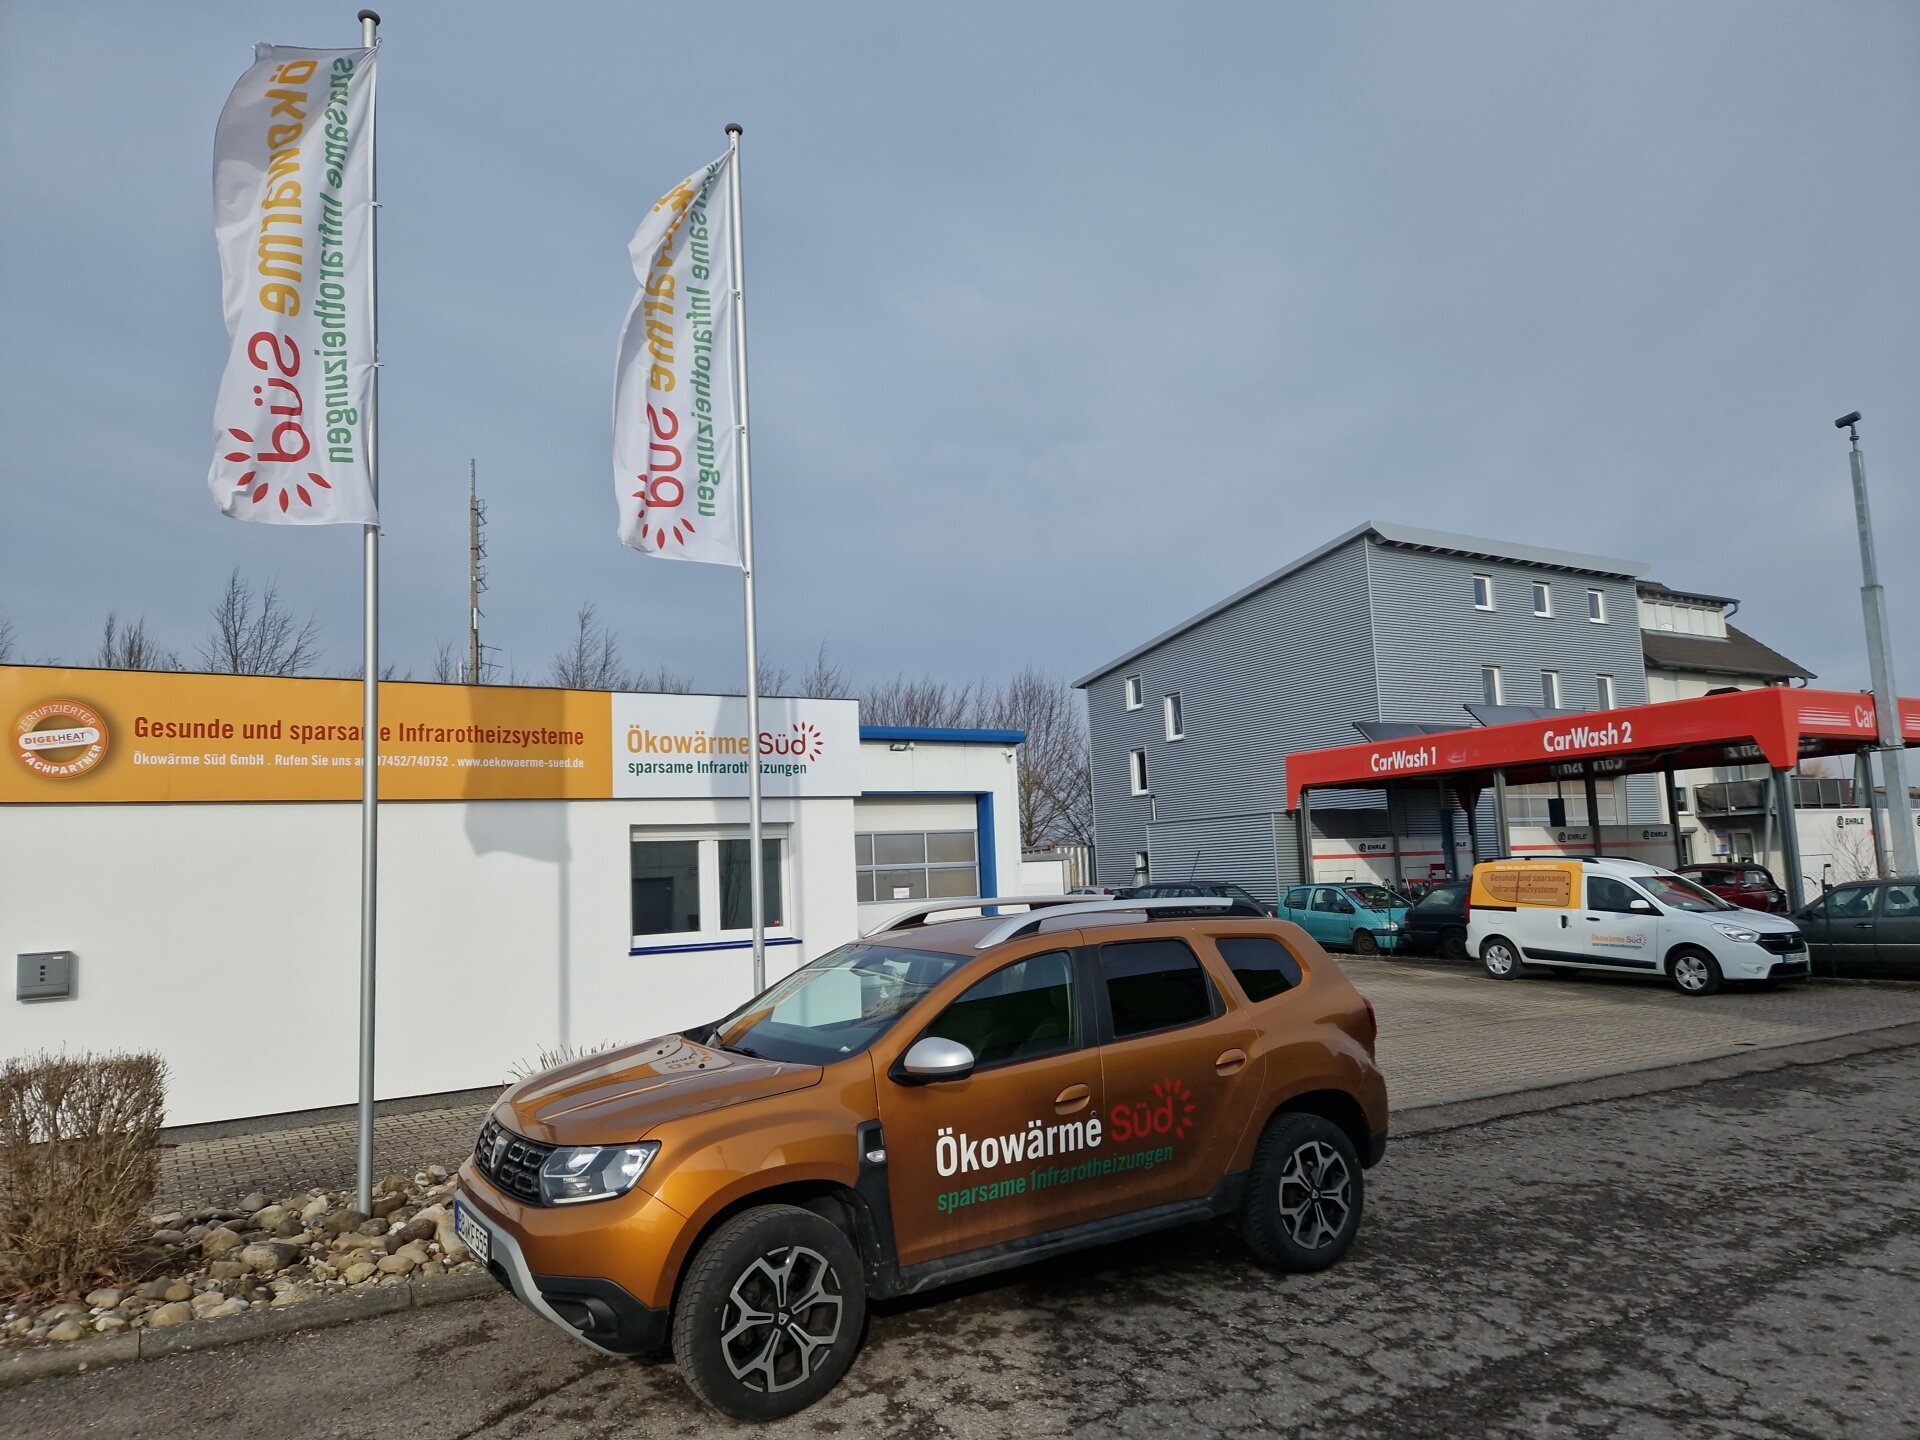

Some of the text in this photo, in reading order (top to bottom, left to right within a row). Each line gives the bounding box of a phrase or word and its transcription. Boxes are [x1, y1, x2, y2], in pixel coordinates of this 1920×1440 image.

[18, 704, 96, 733] ZERTIFIZIERTER
[1854, 704, 1875, 728] Car
[24, 732, 86, 745] DIGELHEAT
[134, 716, 584, 748] Gesunde und sparsae Infrarotheizsysteme
[627, 724, 806, 756] Ökowärme Süd
[1543, 721, 1632, 752] CarWash 2
[21, 744, 102, 775] FACHPARTNER
[133, 751, 200, 766] Ökowärme
[203, 753, 226, 766] Süd
[230, 754, 264, 766] GmbH
[275, 754, 308, 766] Rufen
[311, 754, 328, 766] Sie
[331, 757, 351, 766] uns
[457, 756, 584, 768] www.oekowaerme-sued.de
[628, 760, 807, 777] sparsame Infrarothizungen
[1371, 746, 1437, 772] CarWash 1
[1845, 817, 1864, 825] EHRLE
[935, 1096, 1174, 1177] Ökowärme Süd
[937, 1146, 1173, 1214] sparsame Infrarotheizungen
